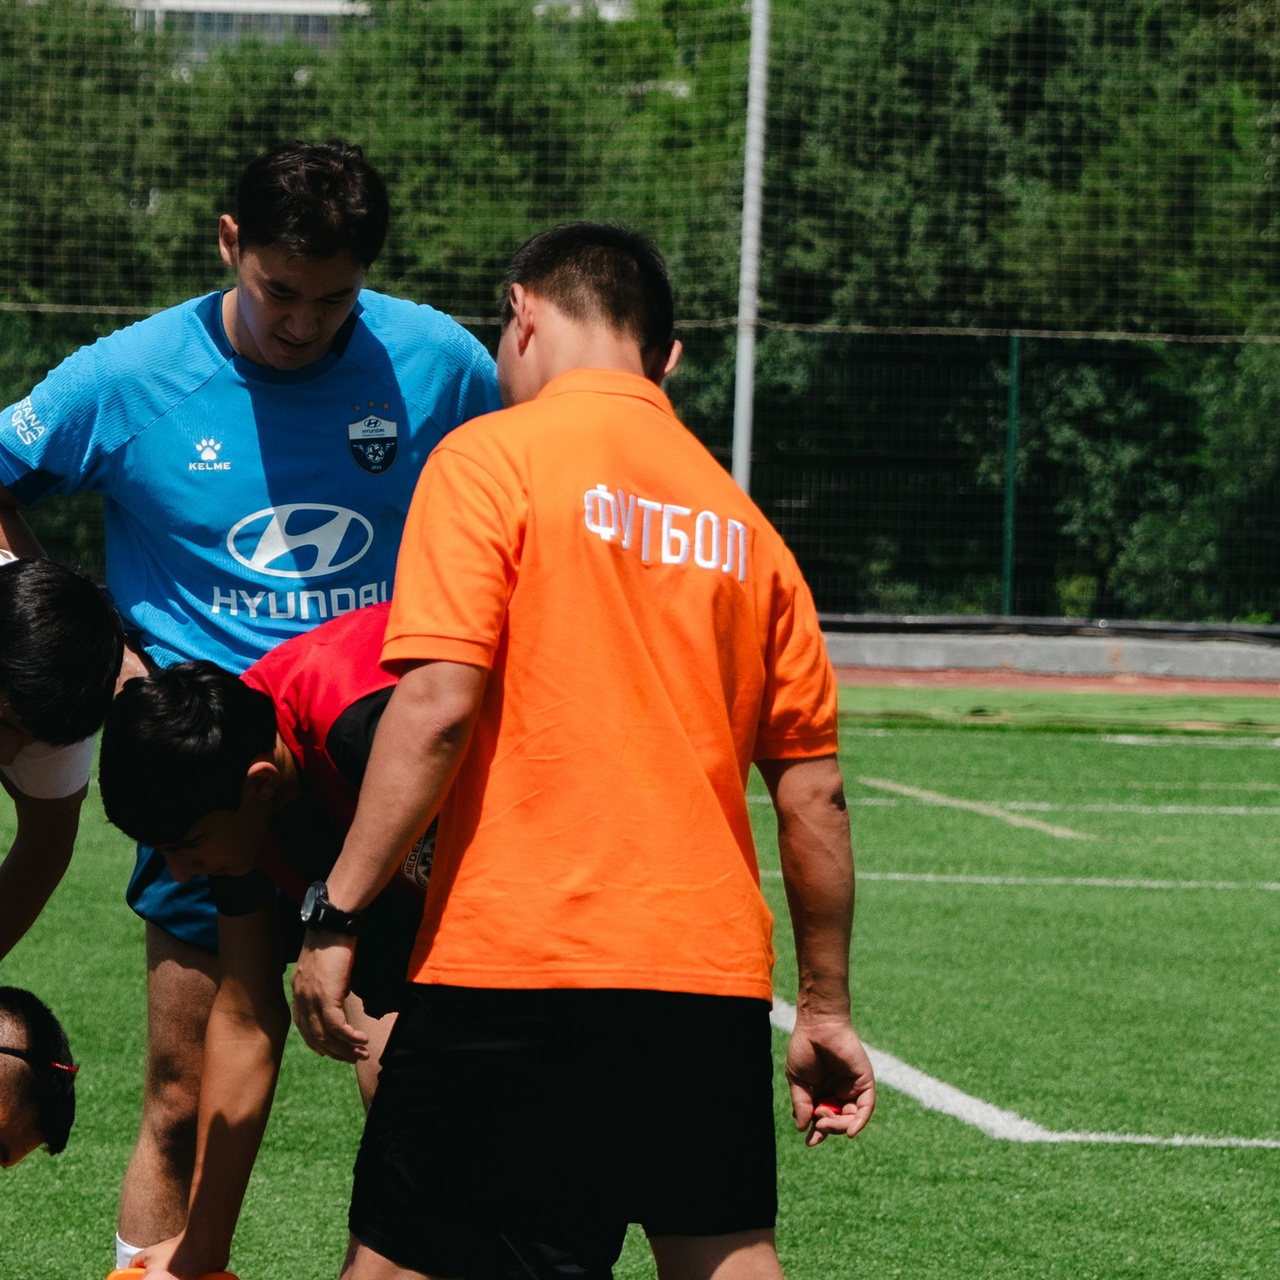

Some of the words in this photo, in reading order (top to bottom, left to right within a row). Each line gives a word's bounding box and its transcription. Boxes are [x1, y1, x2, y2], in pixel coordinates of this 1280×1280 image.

[23, 395, 45, 437] TANA
[189, 461, 231, 470] KELME
[584, 484, 746, 582] ФУТБОЛ
[211, 581, 387, 619] HYUNDAI
